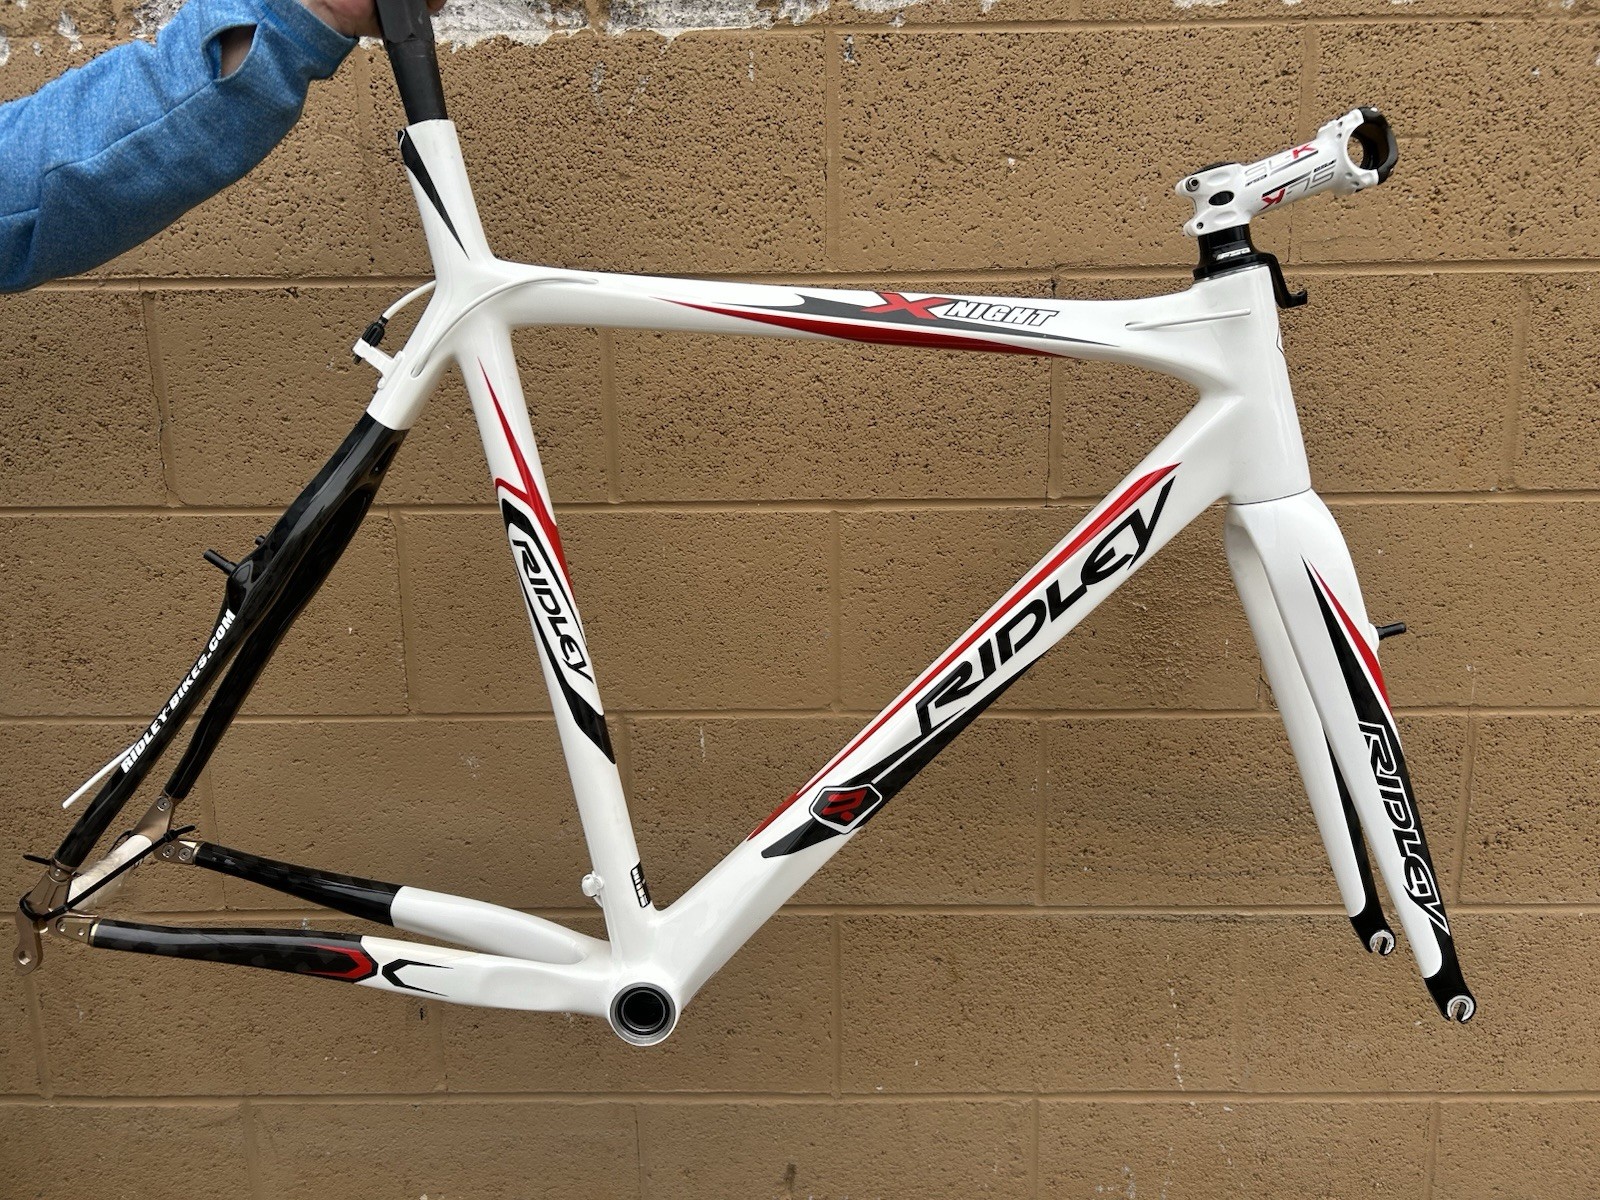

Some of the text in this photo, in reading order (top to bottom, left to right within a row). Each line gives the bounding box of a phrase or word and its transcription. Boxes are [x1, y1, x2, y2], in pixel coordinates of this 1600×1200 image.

[943, 300, 1060, 326] NIGHT
[512, 539, 594, 685] RIDLEY
[915, 475, 1177, 737] RIDLEY
[120, 608, 237, 774] RIDLEY-BIKES.COM
[1357, 720, 1451, 936] RIDLEY
